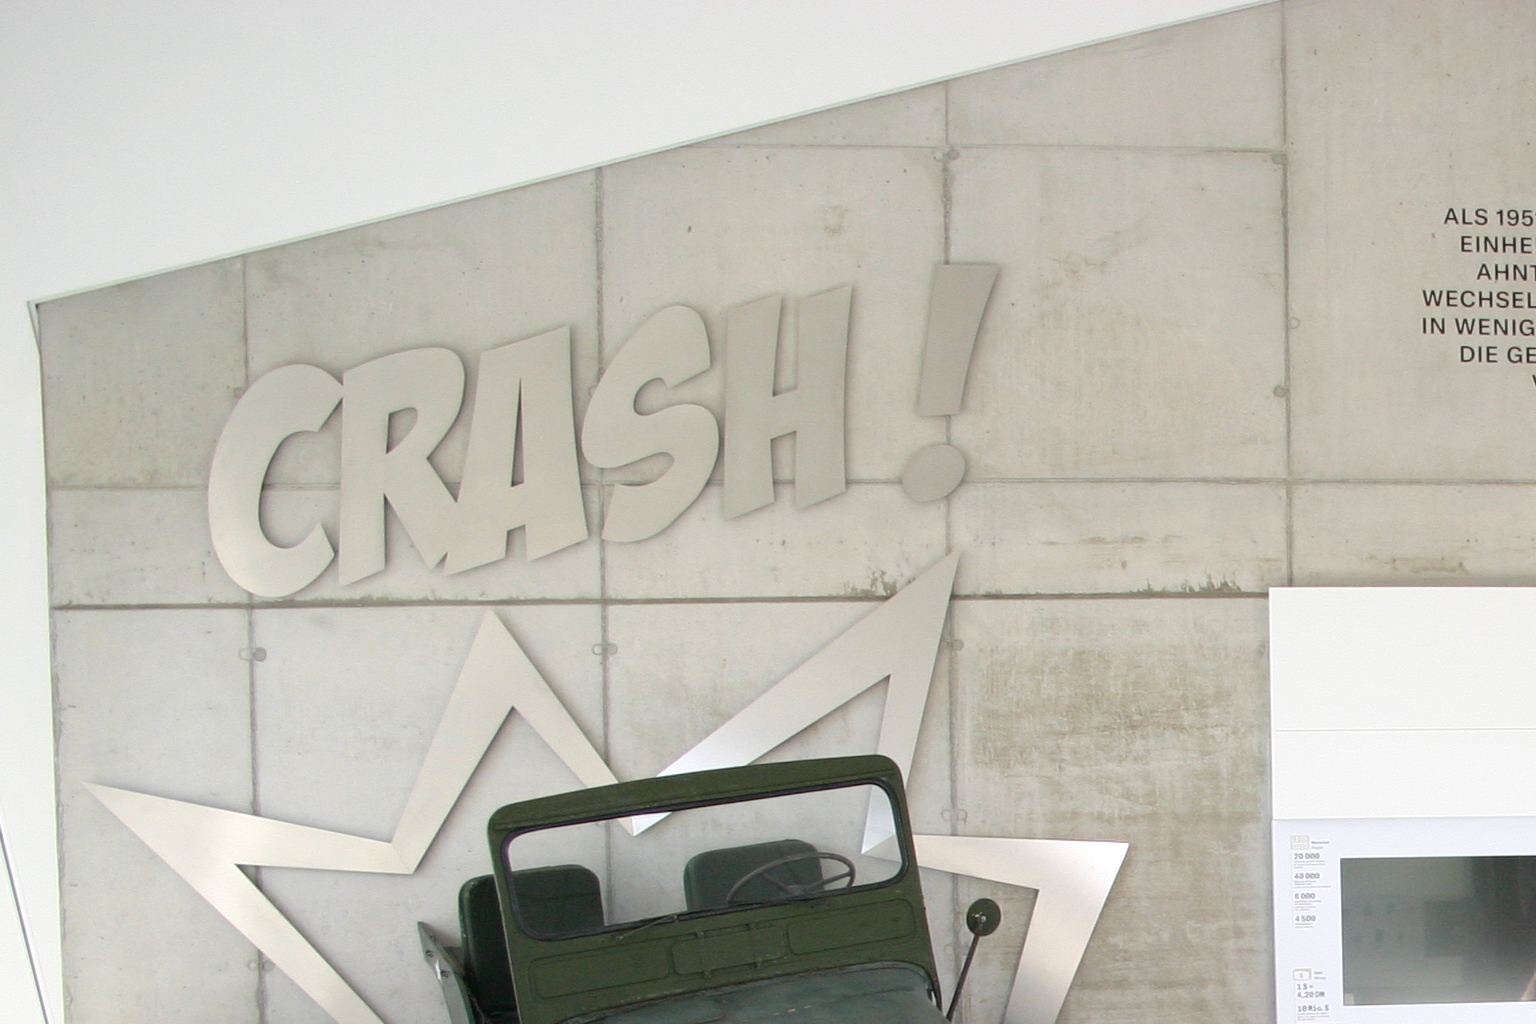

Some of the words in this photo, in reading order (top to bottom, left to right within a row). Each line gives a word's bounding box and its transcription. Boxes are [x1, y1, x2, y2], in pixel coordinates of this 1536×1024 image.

[1443, 207, 1489, 226] ALS
[1422, 317, 1446, 335] IN
[1460, 345, 1498, 364] DIE
[207, 263, 999, 597] CRASH!
